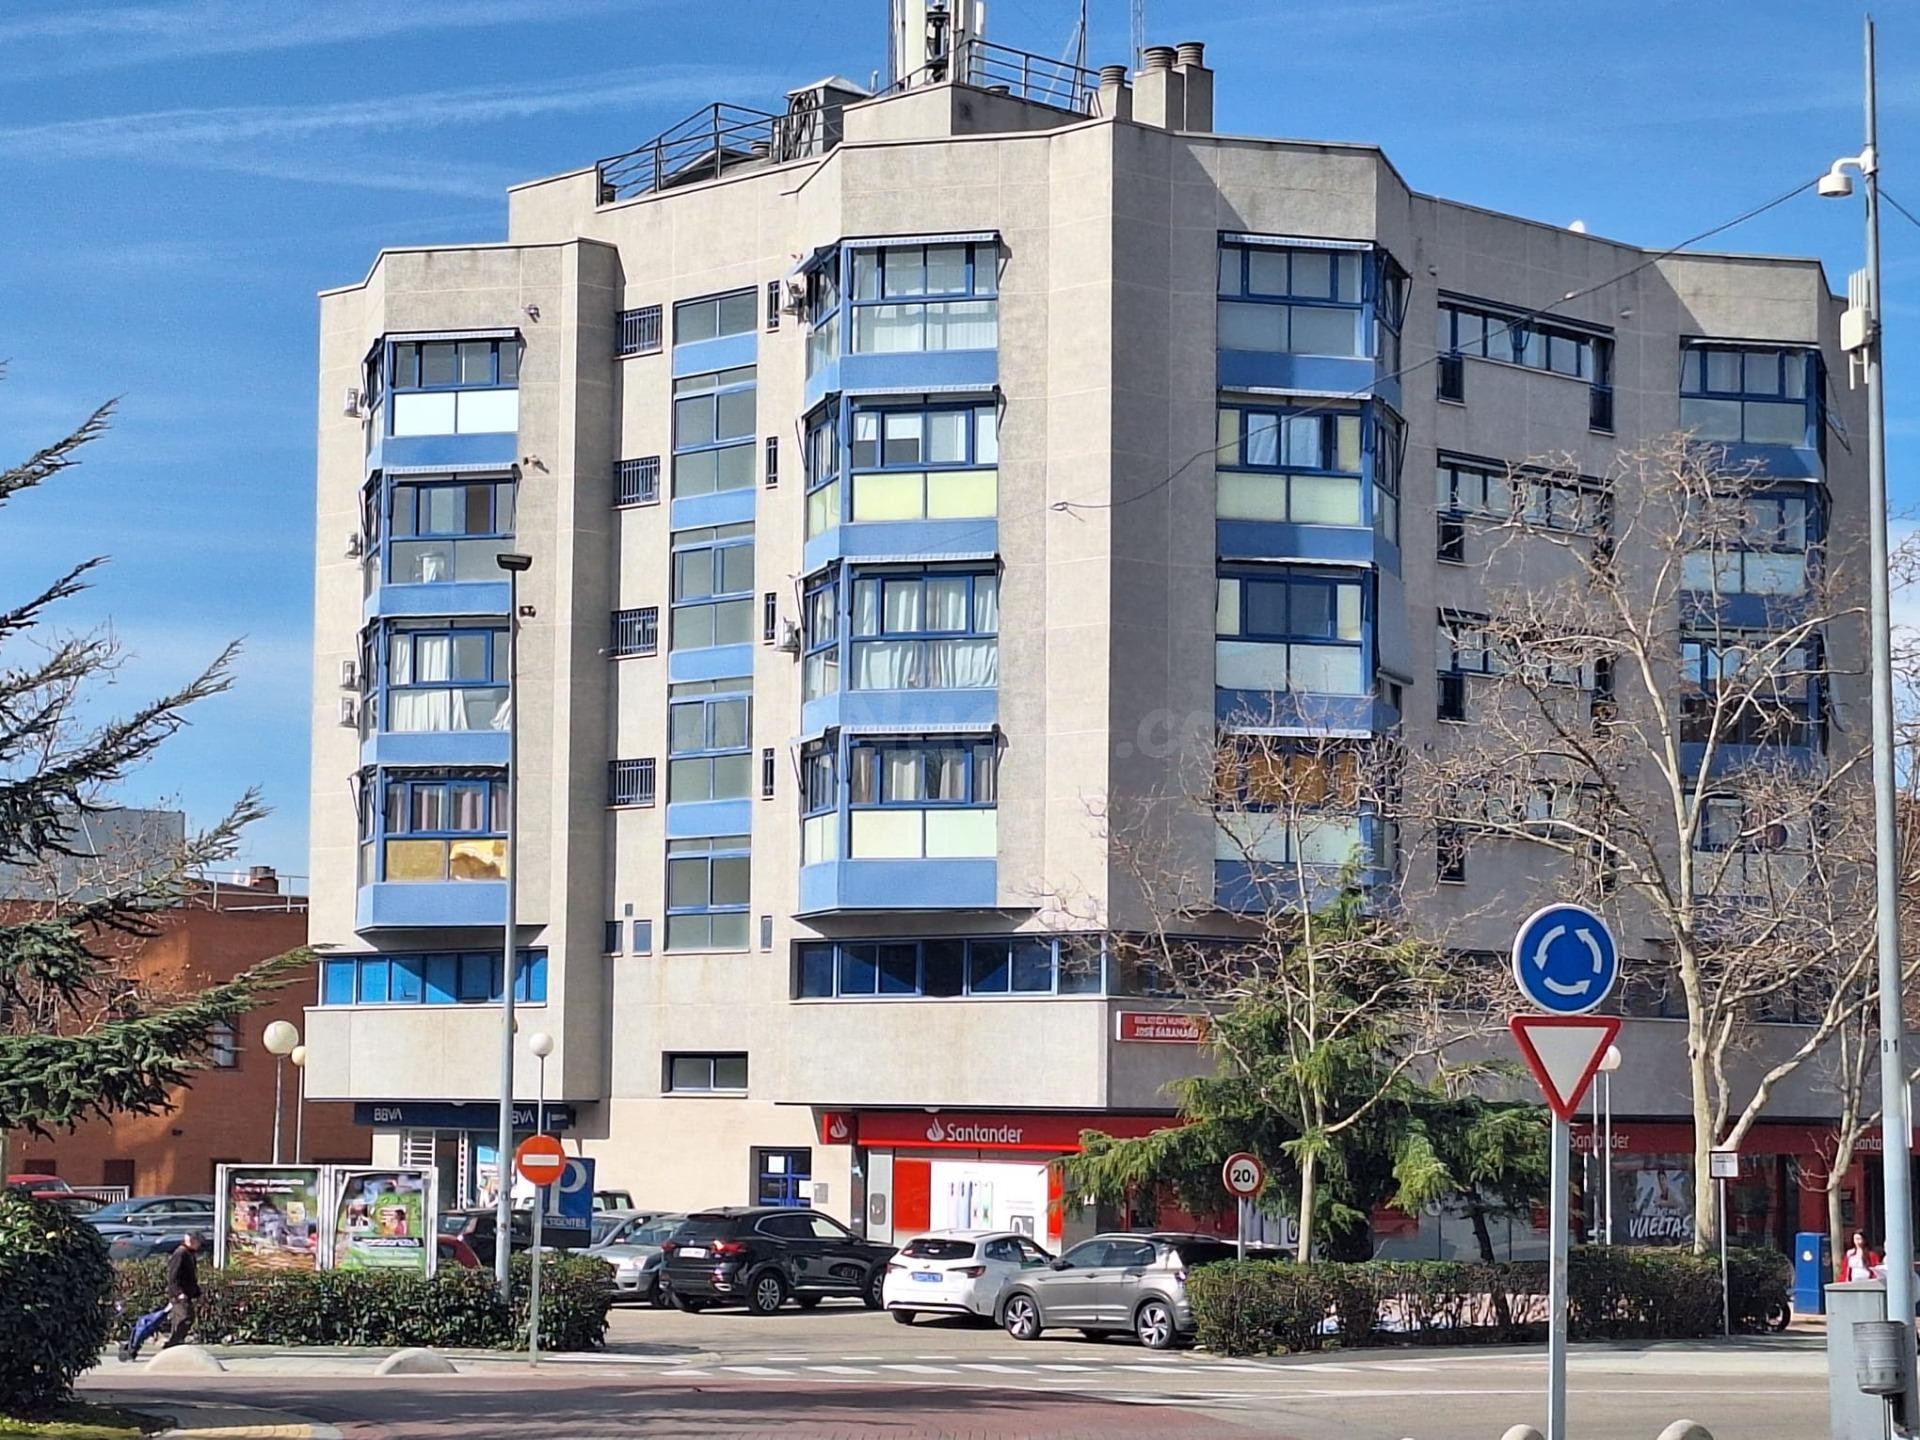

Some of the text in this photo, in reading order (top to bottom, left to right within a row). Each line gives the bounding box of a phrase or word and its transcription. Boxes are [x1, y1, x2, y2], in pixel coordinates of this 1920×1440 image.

[374, 1107, 402, 1121] BBVA
[512, 1109, 534, 1124] BVA
[946, 1123, 1023, 1143] Santander
